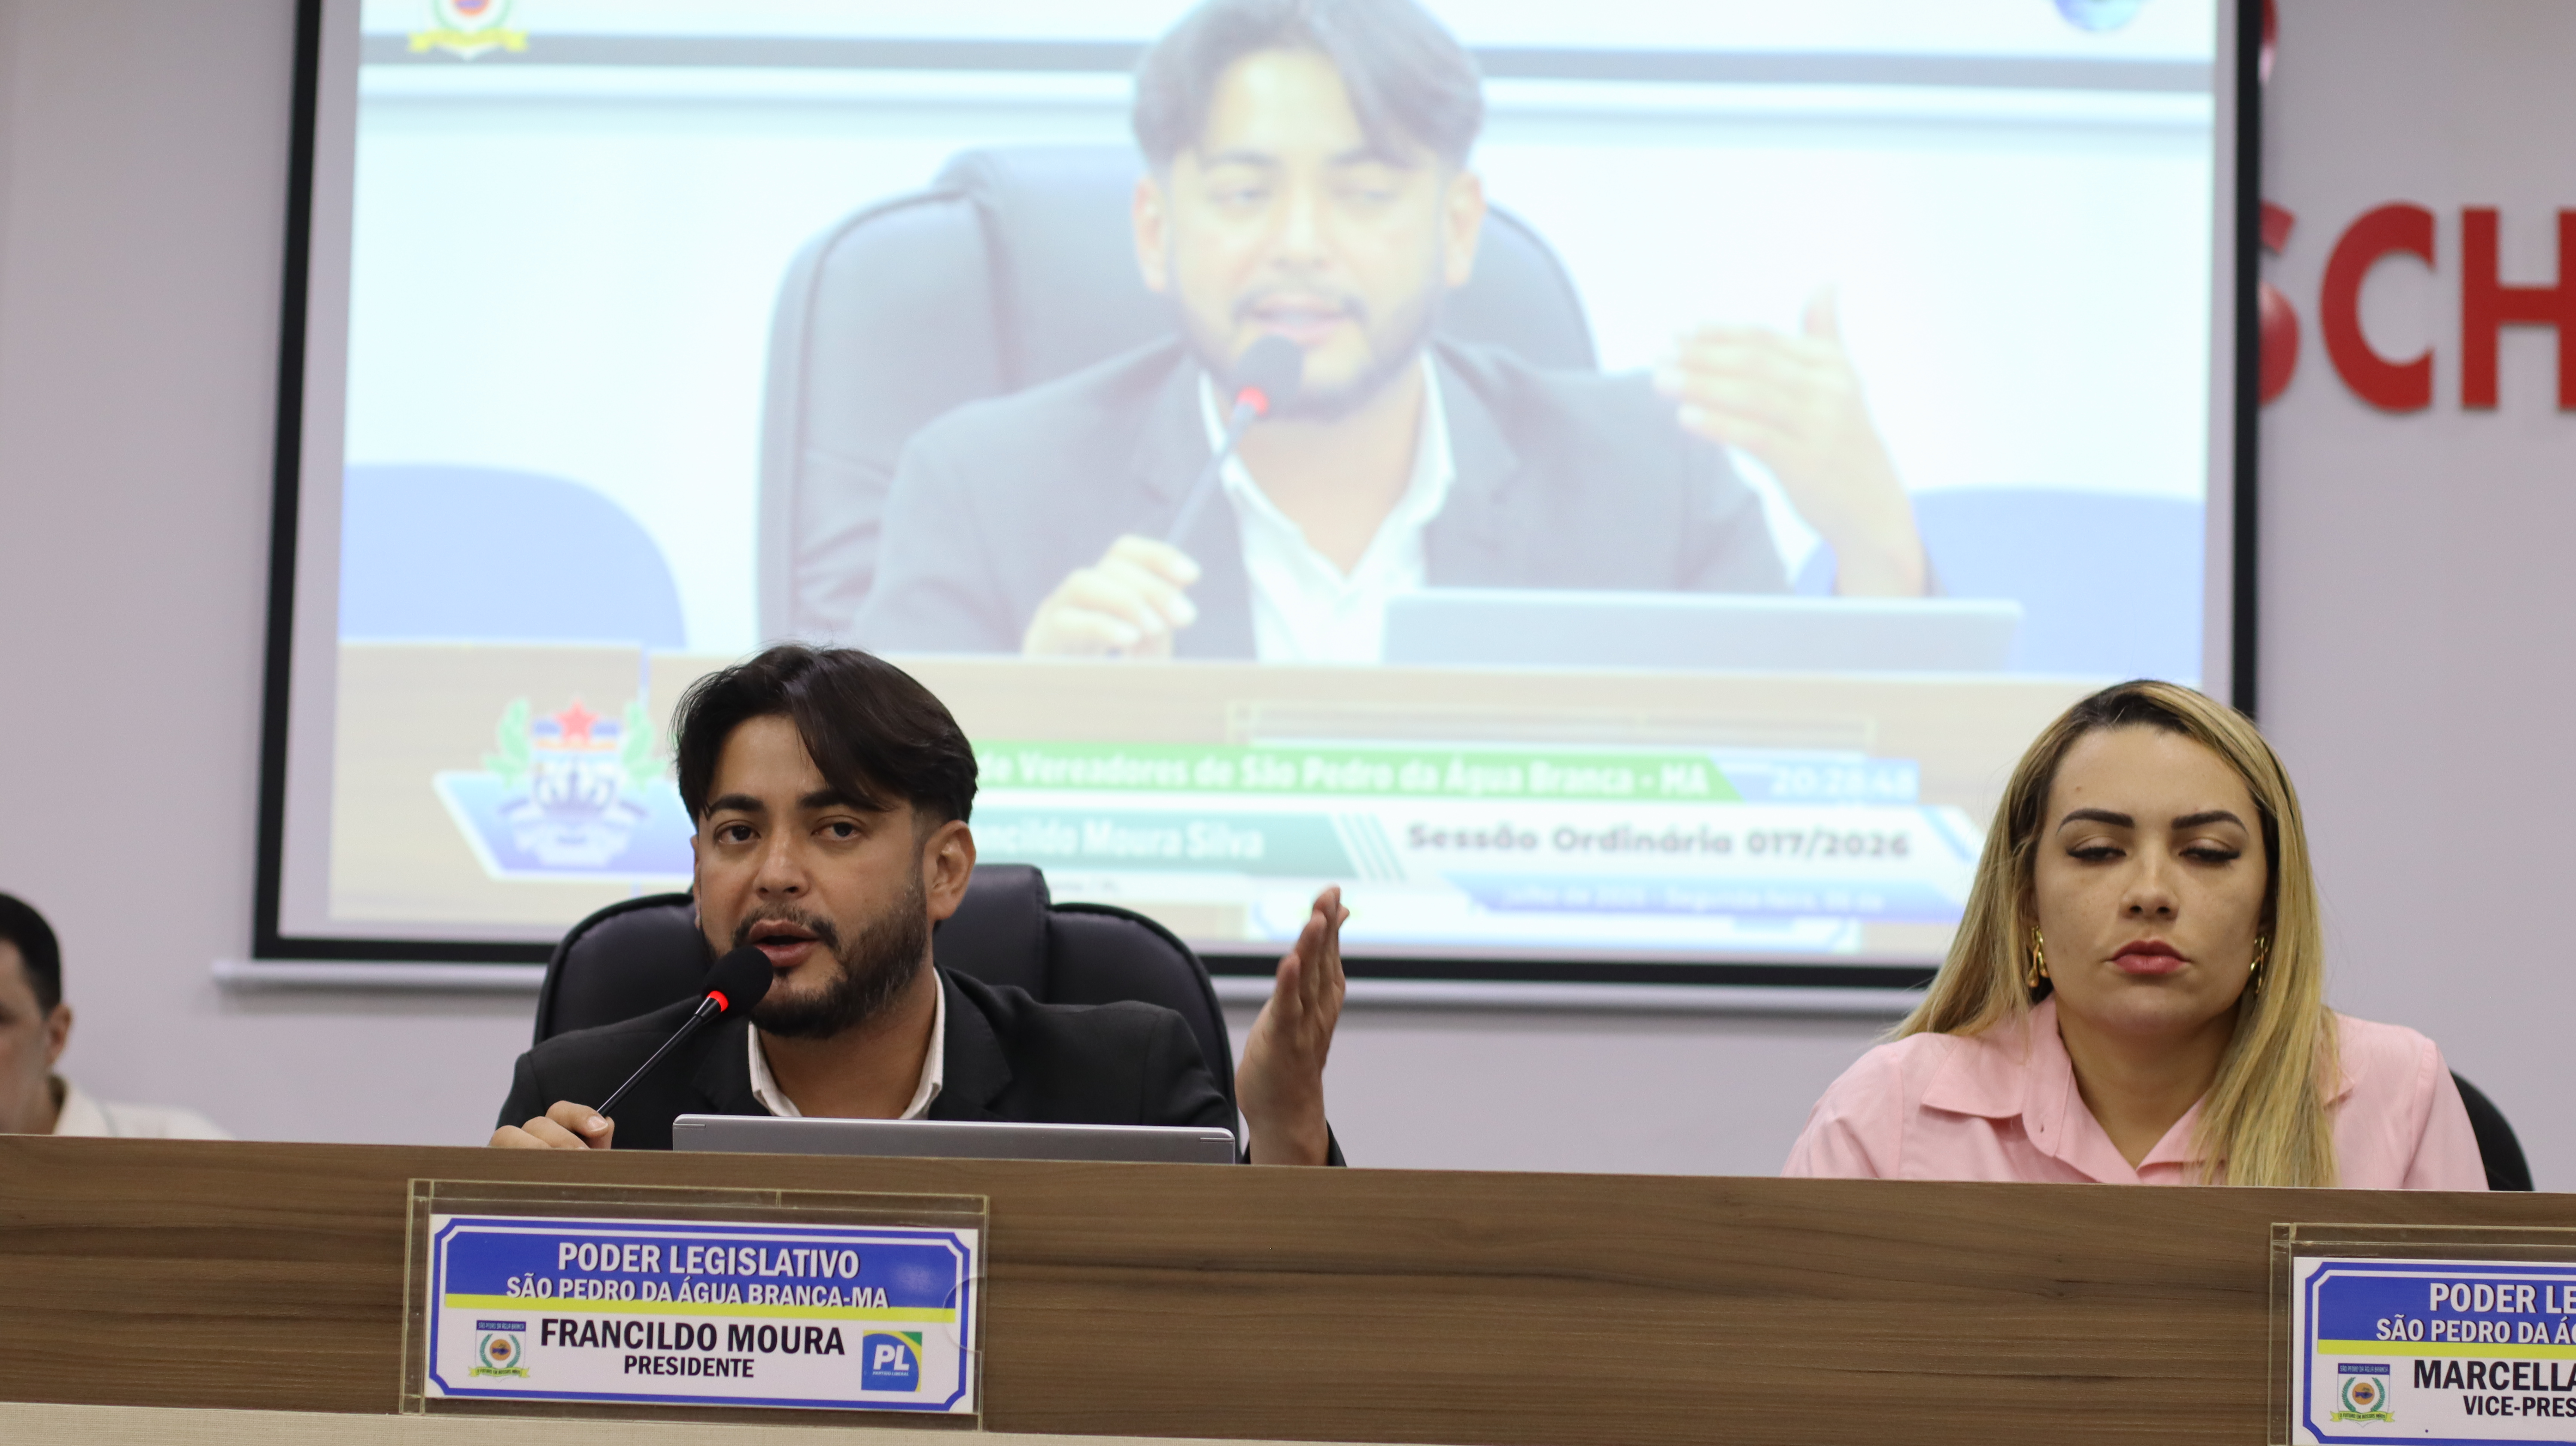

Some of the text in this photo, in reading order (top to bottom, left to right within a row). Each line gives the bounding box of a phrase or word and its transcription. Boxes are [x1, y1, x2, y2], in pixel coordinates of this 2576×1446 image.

[1195, 755, 1234, 789] de
[1242, 754, 1297, 790] São
[1303, 756, 1394, 792] Pedro
[1399, 758, 1438, 793] da
[1444, 754, 1522, 797] Água
[1529, 760, 1634, 796] Branca
[1659, 762, 1710, 797] MA
[1083, 819, 1182, 857] Moura
[1187, 821, 1265, 860] Silva
[1407, 821, 1912, 860] Sessão Ordinária 017/2026
[558, 1242, 860, 1279] PODER LEGISLATIVO
[506, 1272, 890, 1309] SÃO PEDRO DA ÁGUA BRANCA-MA
[2429, 1282, 2576, 1314] PODER LE
[541, 1318, 845, 1355] FRANCILDO MOURA
[2376, 1313, 2576, 1345] SÃO PEDRO DA Á
[624, 1355, 755, 1378] PRESIDENTE
[873, 1344, 910, 1371] PL
[2463, 1395, 2576, 1417] VICE-PRES
